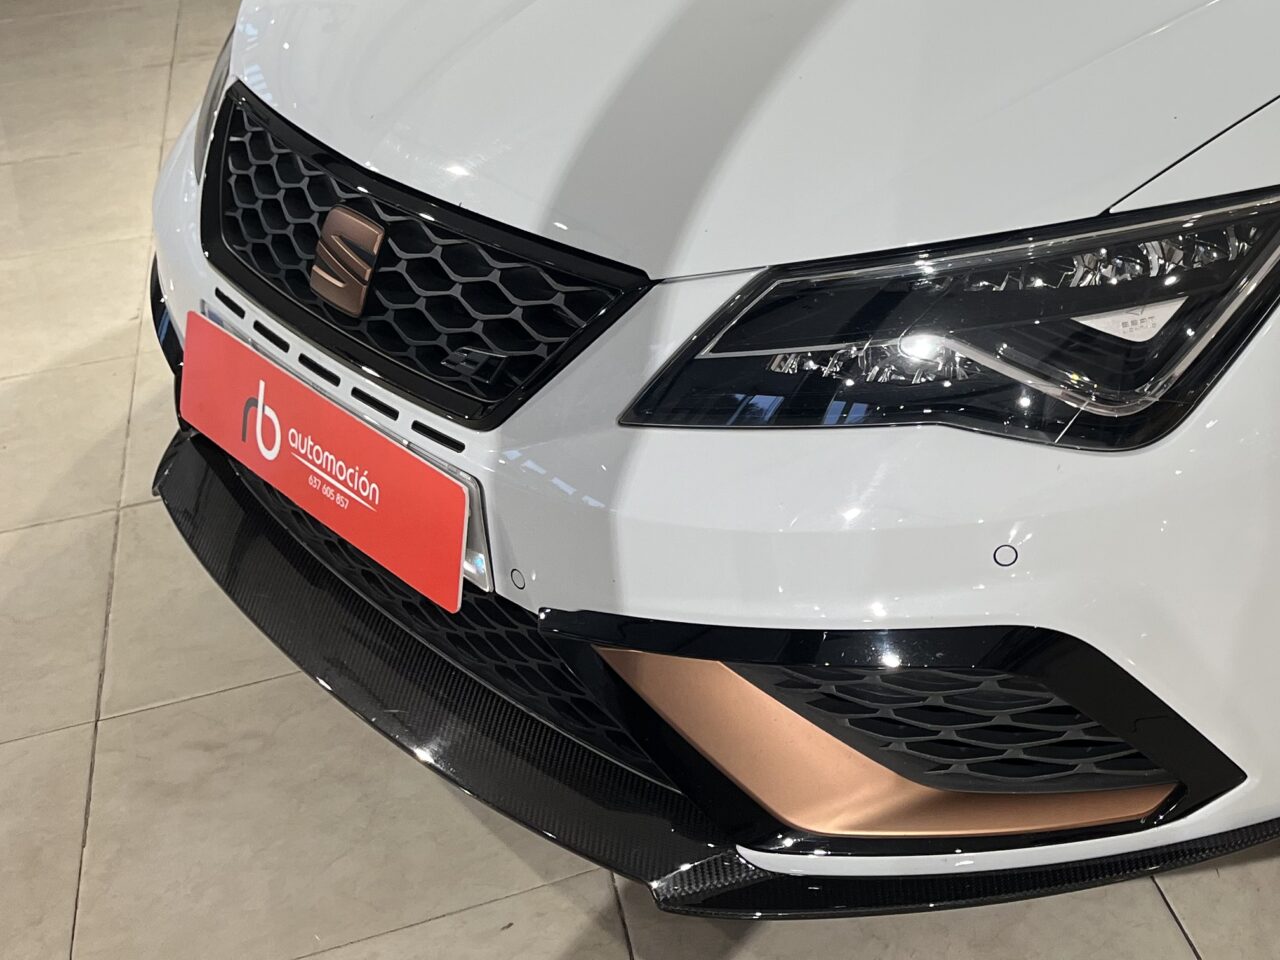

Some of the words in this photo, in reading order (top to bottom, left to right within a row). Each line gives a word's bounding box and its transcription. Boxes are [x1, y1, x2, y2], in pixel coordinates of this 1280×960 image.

[288, 428, 379, 504] automoción
[308, 474, 322, 490] 637
[321, 483, 335, 501] 605
[335, 493, 349, 510] 857
